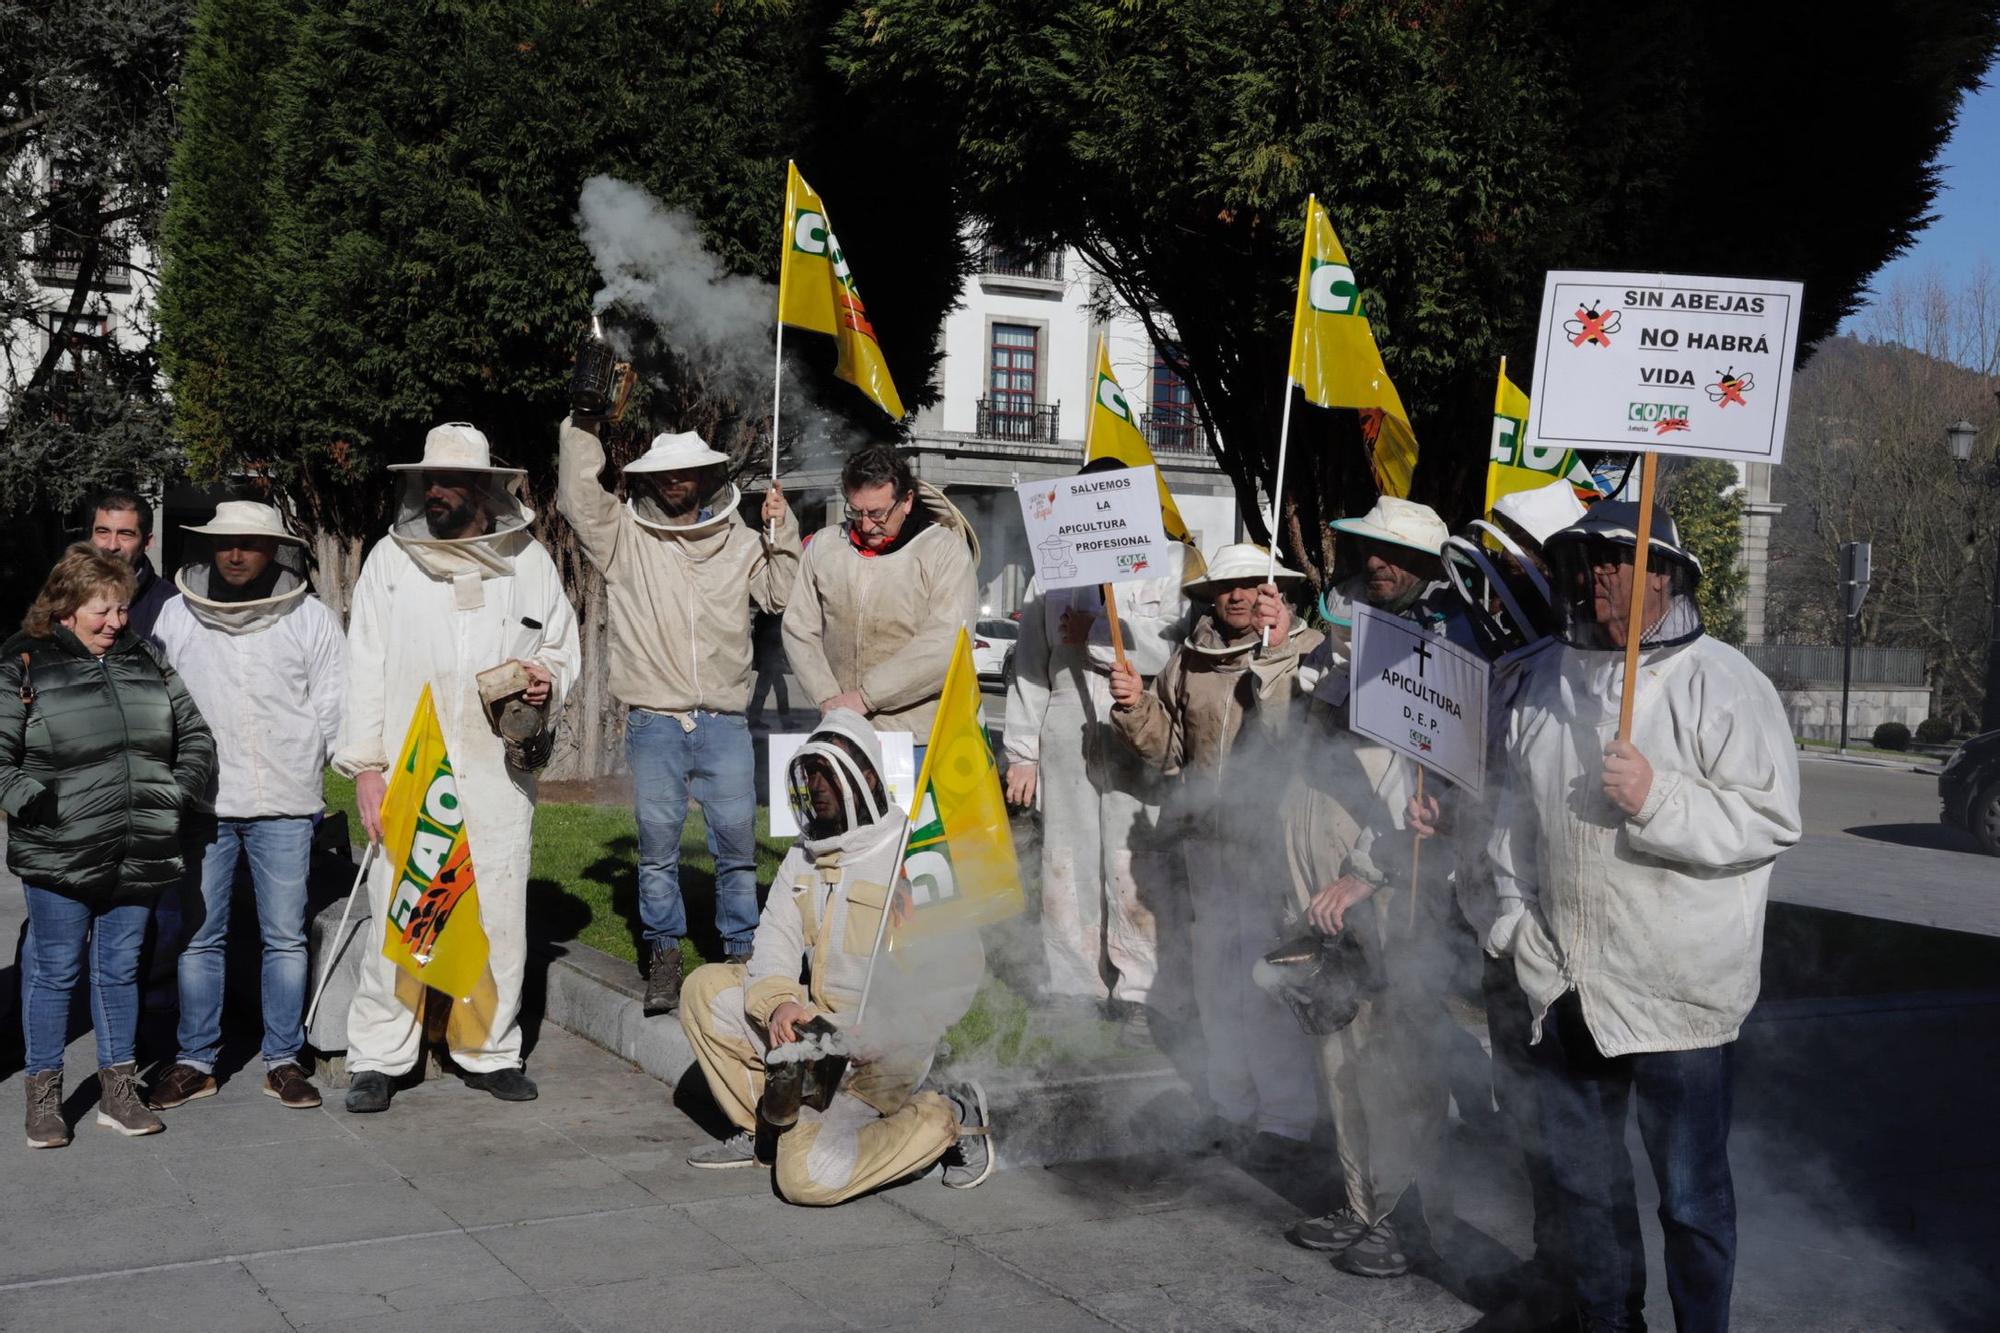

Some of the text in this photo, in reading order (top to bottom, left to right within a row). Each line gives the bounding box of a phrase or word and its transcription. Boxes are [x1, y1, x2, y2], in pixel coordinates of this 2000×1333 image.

[1624, 290, 1765, 313] SIN ABEJAS
[1640, 328, 1769, 354] NO HABRÁ
[1640, 367, 1695, 386] VIDA
[1629, 403, 1688, 421] COAG
[1070, 478, 1131, 495] SALVEMOS
[1096, 501, 1111, 510] LA
[1059, 519, 1127, 535] APICULTURA
[1075, 535, 1152, 552] PROFESIONAL
[1381, 668, 1462, 720] APICULTURA
[1403, 706, 1440, 734] D. E. P.
